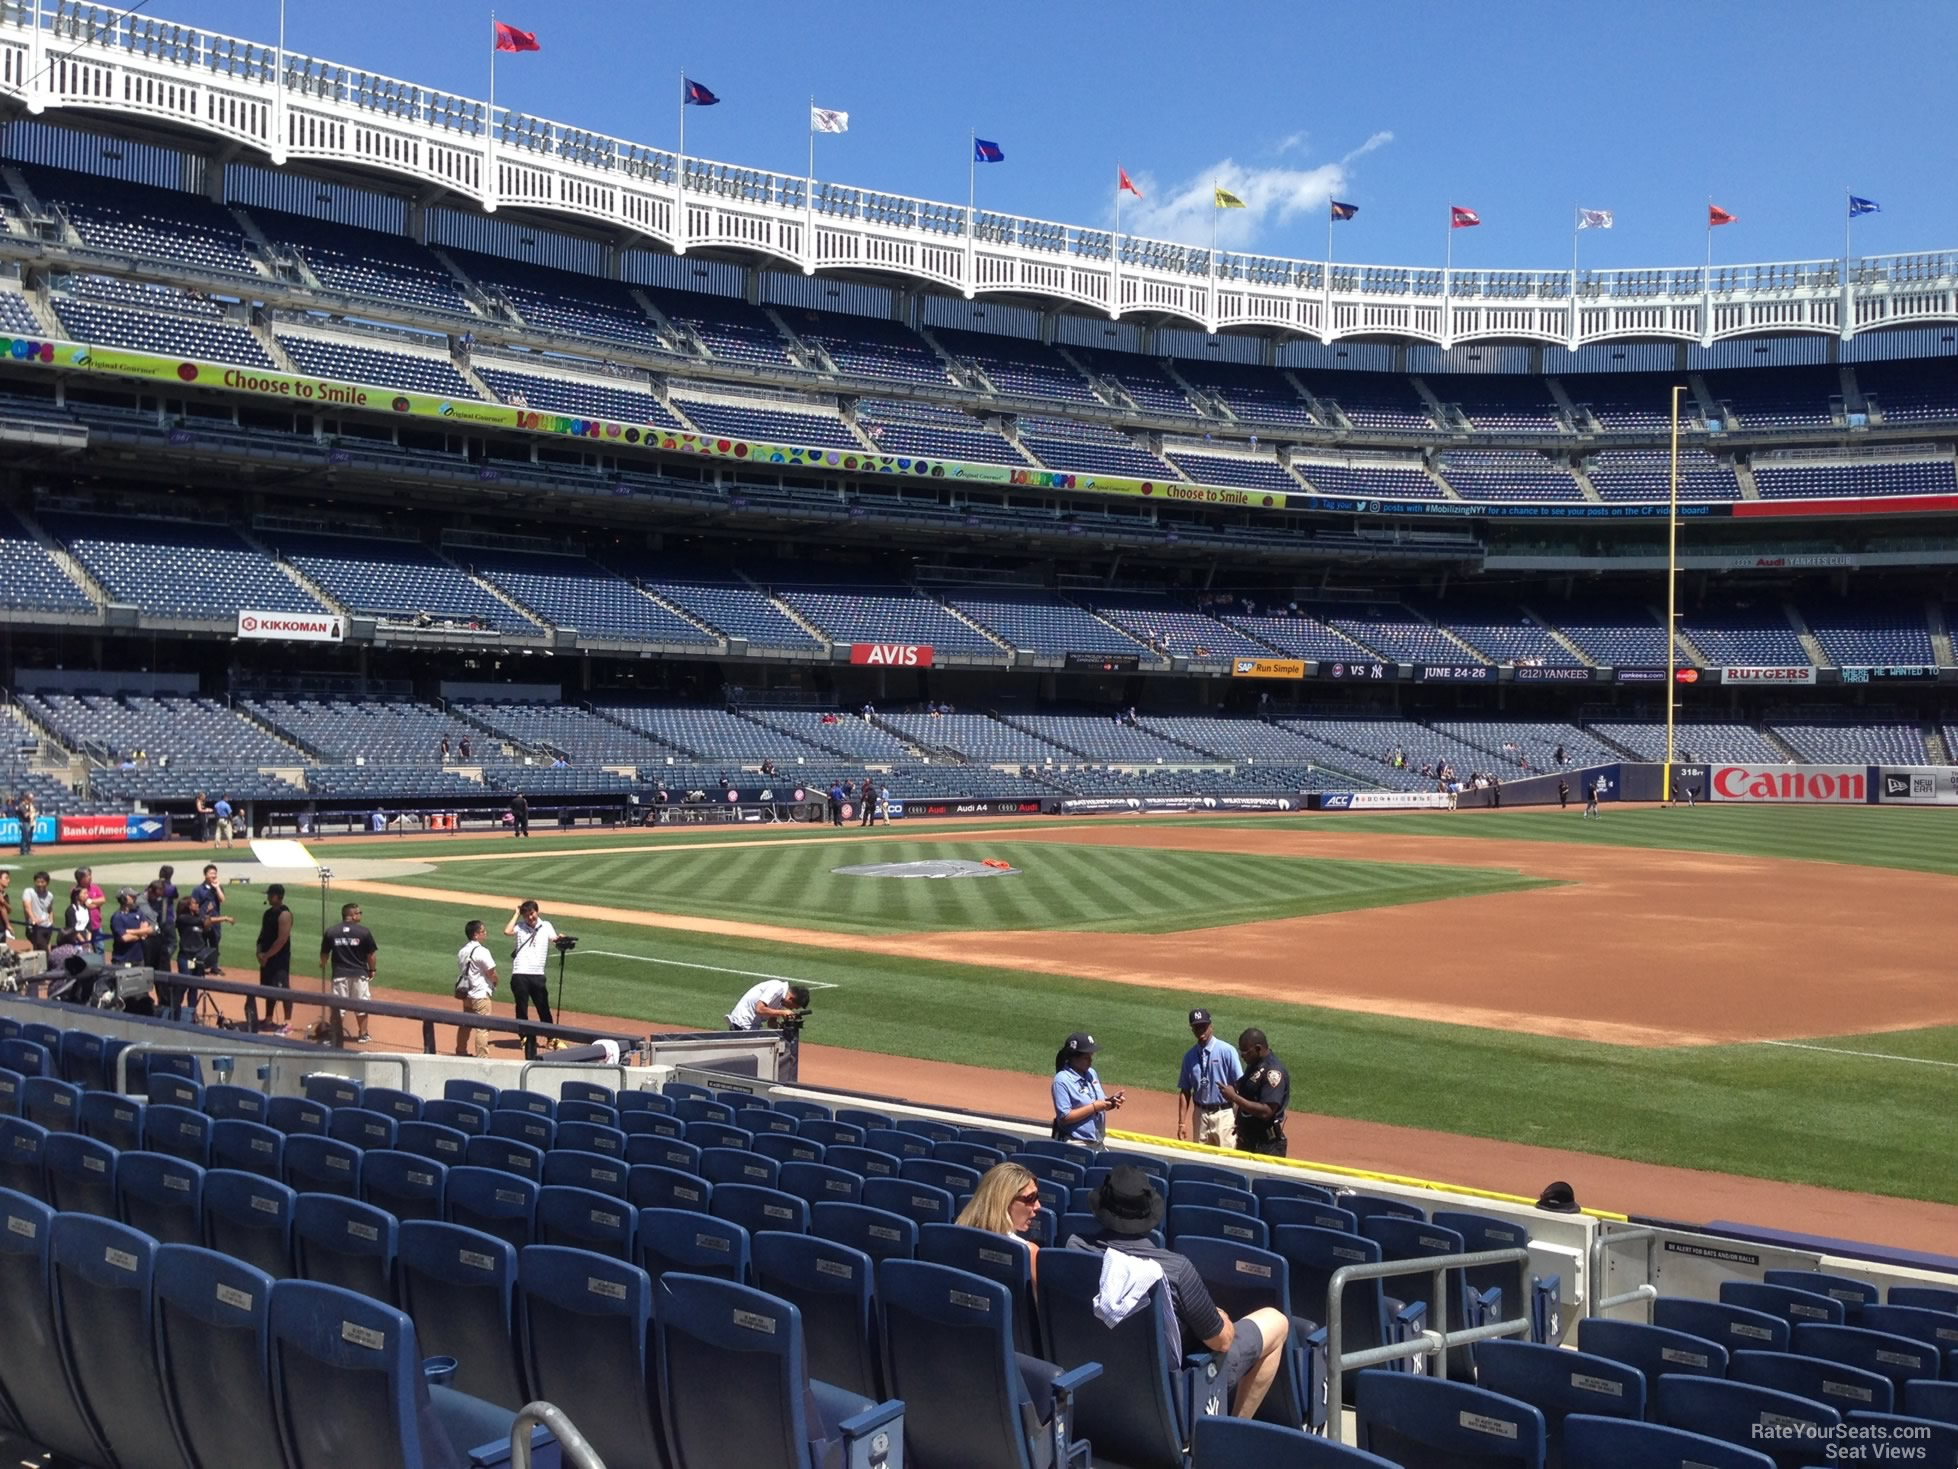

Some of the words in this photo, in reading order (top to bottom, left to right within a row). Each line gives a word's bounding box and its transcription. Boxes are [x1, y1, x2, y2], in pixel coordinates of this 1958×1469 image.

[79, 356, 118, 370] Original
[223, 370, 290, 395] Choose
[294, 381, 314, 398] to
[317, 383, 367, 406] Smile
[444, 408, 474, 421] Original
[516, 410, 601, 439] LOLLIPOPS
[1010, 469, 1076, 490] LOLLIPOPS
[1166, 485, 1204, 501] Choose
[1206, 489, 1217, 502] to
[1219, 489, 1249, 504] Smile
[1323, 499, 1335, 510] Tag
[1336, 501, 1352, 511] your
[1383, 503, 1404, 513] posts
[1406, 504, 1423, 513] with
[1425, 504, 1486, 516] #MobilizingNYY
[1488, 506, 1499, 514] for
[1509, 506, 1538, 515] chance
[1540, 506, 1549, 515] to
[1567, 508, 1585, 517] your
[1587, 507, 1609, 516] posts
[1625, 506, 1639, 515] the
[1641, 506, 1653, 515] CF
[1681, 506, 1709, 515] board!
[1757, 559, 1785, 567] Audi
[1788, 557, 1827, 566] YANKEES
[1829, 556, 1852, 565] CLUB
[261, 619, 328, 632] KIKKOMAN
[867, 645, 918, 666] AVIS
[1237, 662, 1255, 673] SAP
[1256, 663, 1272, 673] Run
[1273, 664, 1300, 675] Simple
[1351, 665, 1365, 676] VS
[1424, 667, 1451, 679] JUNE
[1519, 668, 1543, 679] (212)
[1544, 668, 1589, 679] YANKEES
[1727, 668, 1809, 680] RUTGERS
[1889, 667, 1923, 676] WANTED
[1928, 667, 1940, 675] TO
[1713, 767, 1864, 799] Canon
[1913, 779, 1933, 787] NEW
[1913, 785, 1933, 793] ERA
[1327, 796, 1349, 805] ACC
[957, 805, 974, 813] Audi
[975, 804, 988, 812] A4
[63, 826, 90, 837] Bank
[98, 825, 138, 836] America
[1676, 1245, 1693, 1253] ALERT
[1692, 1247, 1703, 1256] FOR
[1703, 1249, 1717, 1257] BATS
